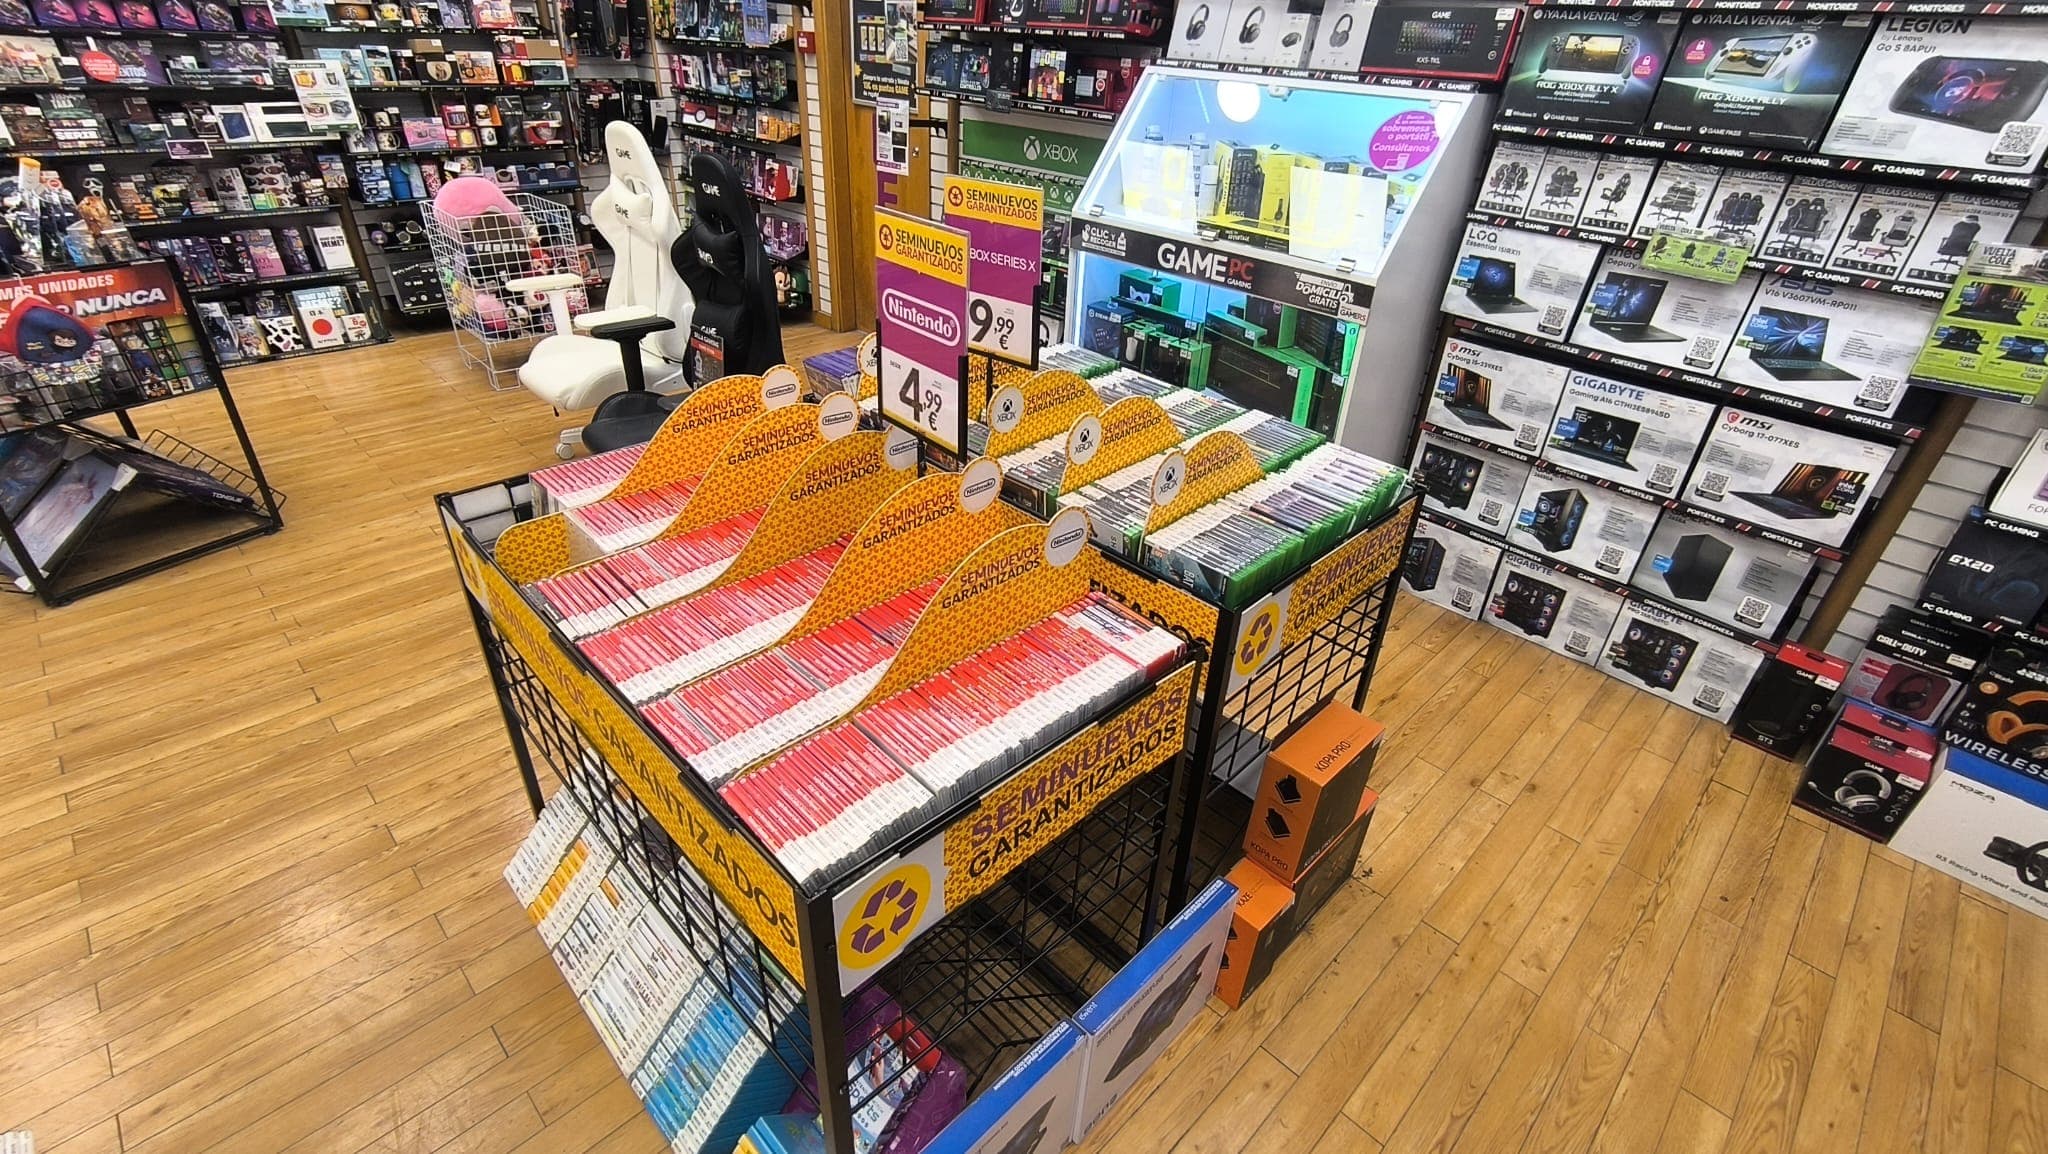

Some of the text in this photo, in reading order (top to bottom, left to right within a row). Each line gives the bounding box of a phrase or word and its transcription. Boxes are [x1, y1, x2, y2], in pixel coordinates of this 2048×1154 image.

[1714, 1, 1762, 9] MONITORES
[1806, 2, 1858, 11] MONITORES
[1906, 4, 1966, 14] MONITORES
[1432, 11, 1452, 19] GAME
[1750, 16, 1795, 26] VENTA!
[1886, 17, 1973, 34] LEGION
[1876, 43, 1893, 52] Go
[1894, 44, 1902, 52] S
[1558, 82, 1584, 91] XBOX
[1610, 86, 1620, 94] X
[1382, 125, 1431, 133] sobremesa
[615, 147, 632, 160] GAME
[1043, 141, 1079, 164] XBOX
[1372, 142, 1432, 153] Consúltanos
[1781, 154, 1830, 167] PC GAMING
[1872, 163, 1926, 177] PC GAMING
[1971, 173, 2031, 187] PC GAMING
[701, 182, 721, 197] GAME
[877, 172, 898, 207] E
[1875, 186, 1936, 201] SILLAS GAMING
[965, 188, 1039, 211] SEMINUEVOS
[614, 203, 630, 219] GAME
[965, 201, 1038, 222] GARANTIZADOS
[1089, 236, 1117, 249] RECOGER
[1090, 227, 1117, 241] CLIC Y
[1469, 227, 1498, 243] LOQ
[320, 239, 345, 248] MEME?
[895, 228, 965, 262] SEMINUEVOS
[1466, 239, 1497, 251] Essential
[1983, 245, 2017, 257] VUELTA
[895, 243, 964, 275] GARANTIZADOS
[968, 247, 1038, 273] BOX SERIES X
[1157, 242, 1229, 283] GAME
[1229, 258, 1255, 281] PC
[1607, 257, 1638, 270] Deputy
[1988, 254, 2014, 265] COLE
[38, 273, 116, 294] UNIDADES
[1226, 277, 1252, 290] GAMING
[1802, 269, 1850, 283] PC GAMING
[1296, 281, 1350, 304] DOMICILIO
[1769, 277, 1835, 297] ASUS
[1890, 284, 1945, 299] PC GAMING
[75, 287, 167, 317] NUNCA
[1308, 294, 1339, 309] GRATIS
[1764, 287, 1860, 312] V16 V3607VM-RP011
[886, 296, 954, 340] Nintendo
[968, 298, 1015, 343] 9,99
[1340, 308, 1368, 322] GAMERS
[998, 334, 1010, 350] €
[1447, 352, 1471, 365] Cyborg
[1458, 346, 1482, 358] msi
[1610, 357, 1649, 372] PORTÁTILES
[768, 385, 796, 396] Nintendo
[1572, 374, 1646, 402] GIGABYTE
[1681, 373, 1723, 390] PORTÁTILES
[898, 367, 943, 423] 4,99
[1026, 382, 1077, 406] SEMINUEVOS
[1026, 387, 1087, 416] GARANTIZADOS
[1568, 388, 1599, 402] Gaming
[1599, 395, 1613, 405] A16
[1760, 392, 1805, 410] PORTÁTILES
[686, 392, 757, 419] SEMINUEVOS
[671, 403, 759, 434] GARANTIZADOS
[824, 413, 852, 425] Nintendo
[928, 412, 938, 432] €
[996, 410, 1018, 424] XBOX
[1104, 409, 1153, 436] SEMINUEVOS
[1739, 416, 1775, 431] msi
[1845, 412, 1894, 431] PORTÁTILES
[742, 419, 815, 450] SEMINUEVOS
[1102, 415, 1162, 447] GARANTIZADOS
[1721, 423, 1801, 449] Cyborg 17-077XES
[727, 430, 817, 466] GARANTIZADOS
[1073, 440, 1095, 455] XBOX
[805, 451, 879, 484] SEMINUEVOS
[1188, 445, 1236, 473] SEMINUEVOS
[1185, 451, 1243, 486] GARANTIZADOS
[790, 461, 882, 502] GARANTIZADOS
[965, 479, 995, 495] Nintendo
[1158, 480, 1179, 495] XBOX
[1838, 481, 1857, 490] intel
[1618, 485, 1655, 502] PORTÁTILES
[879, 490, 955, 531] SEMINUEVOS
[1686, 507, 1726, 525] PORTÁTILES
[862, 501, 957, 549] GARANTIZADOS
[1984, 518, 2040, 538] PC GAMING
[1052, 530, 1083, 547] Nintendo
[1761, 530, 1804, 550] PORTÁTILES
[960, 543, 1041, 588] SEMINUEVOS
[1302, 513, 1411, 600] SEMINUEVOS
[1506, 553, 1554, 577] GIGABYTE
[1948, 553, 1996, 574] GX20
[942, 556, 1041, 610] GARANTIZADOS
[1293, 544, 1402, 629] GARANTIZADOS
[1630, 601, 1684, 627] GIGABYTE
[1643, 598, 1694, 624] ORDENADORES
[1922, 602, 1974, 623] PC GAMING
[1876, 633, 1898, 648] CALL
[1901, 643, 1928, 657] DUTY
[1796, 669, 1816, 681] GAME
[1757, 733, 1774, 746] ST3
[1874, 734, 1895, 747] GAME
[1314, 740, 1352, 772] KOPA PRO
[487, 585, 799, 950] SEMINUEVOS GARANTIZADOS
[969, 684, 1185, 850] SEMINUEVOS
[1864, 761, 1885, 774] GAME
[968, 717, 1179, 880] GARANTIZADOS
[1951, 780, 1996, 802] MOZA
[1250, 841, 1289, 872] KOPA PRO
[1948, 859, 1979, 877] Racing
[1980, 873, 2010, 890] Wheel
[2009, 887, 2028, 899] and
[1235, 889, 1254, 907] KAZE
